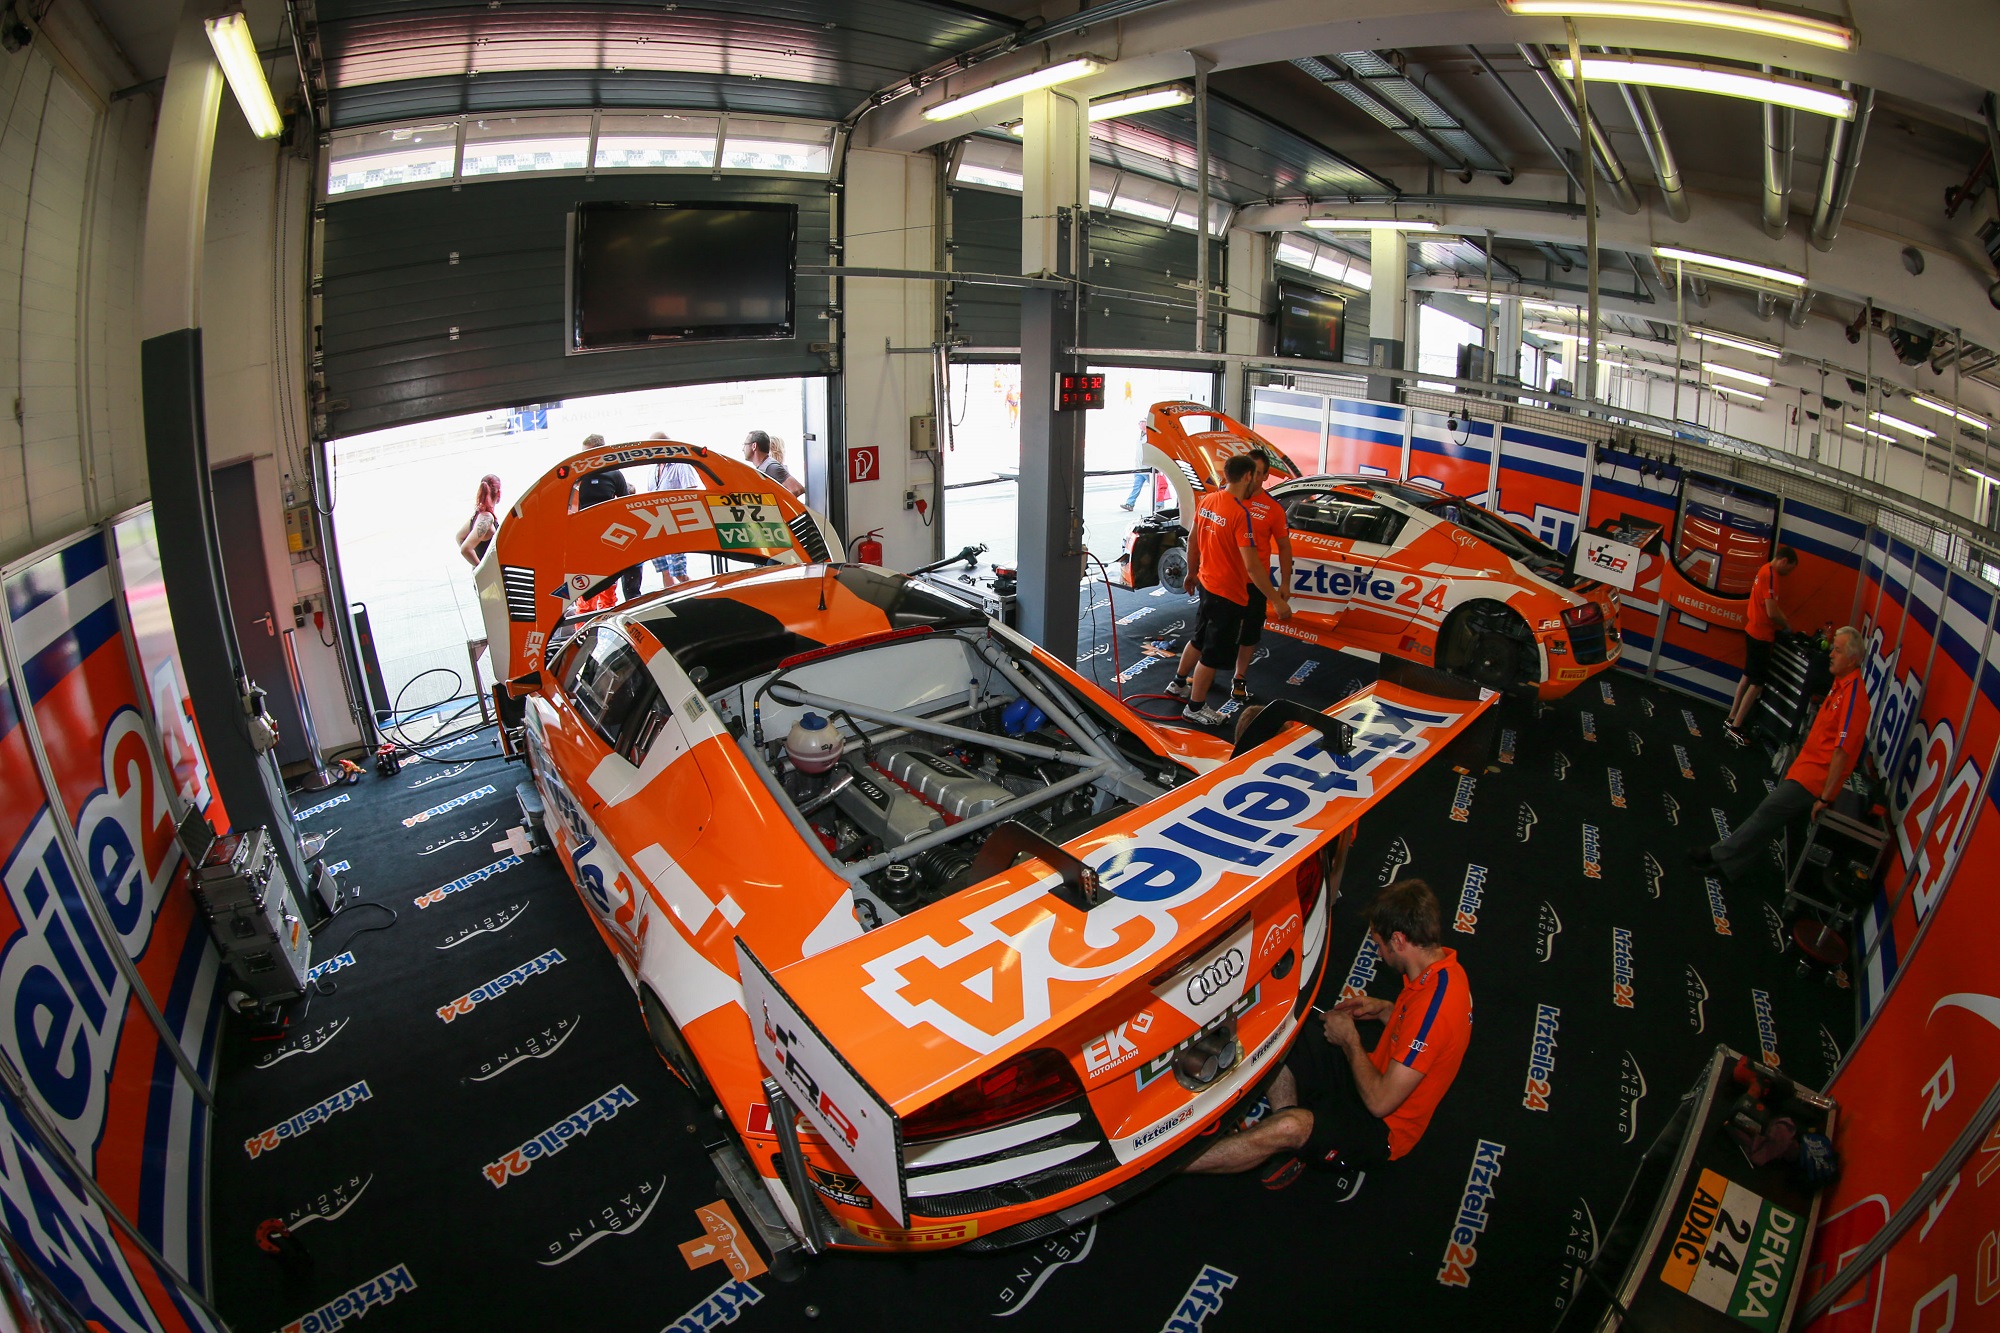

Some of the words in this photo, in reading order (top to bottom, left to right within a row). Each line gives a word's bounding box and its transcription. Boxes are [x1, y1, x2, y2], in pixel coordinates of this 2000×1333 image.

[571, 445, 692, 474] kfzteile24
[626, 493, 698, 510] AUTOMATION
[629, 500, 714, 540] EK
[730, 505, 766, 522] 24
[718, 527, 791, 545] DEKRA
[1288, 532, 1343, 548] ETSCHEK
[1677, 595, 1743, 623] NEMETSCHEK
[531, 631, 545, 658] EK
[402, 785, 497, 828] kfzteile24
[1449, 775, 1476, 823] kfzteile24
[426, 821, 489, 851] RACING
[1516, 805, 1526, 838] RACING
[1378, 840, 1400, 883] RACING
[1395, 850, 1406, 864] MS
[1583, 823, 1601, 879] kfzteile24
[414, 855, 524, 909] kfzteile24
[862, 694, 1462, 1055] kfzteile24
[1644, 855, 1655, 894] RACING
[1453, 863, 1488, 934] kfzteile24
[1704, 876, 1732, 936] kfzteile24
[445, 904, 519, 944] RACING
[486, 915, 510, 930] MS
[1263, 919, 1297, 957] RACING
[1268, 930, 1281, 943] MS
[1535, 905, 1548, 956] RACING
[1547, 917, 1554, 933] MS
[1762, 905, 1779, 949] RACING
[436, 948, 567, 1024] kfzteile24
[1613, 927, 1634, 1009] kfzteile24
[1685, 969, 1698, 1027] RACING
[1695, 981, 1703, 1000] MS
[262, 1019, 338, 1063] RACING
[301, 1034, 327, 1050] MS
[480, 1020, 567, 1072] RACING
[530, 1036, 557, 1054] MS
[1081, 1020, 1137, 1073] EK
[1752, 989, 1780, 1067] kfzteile2
[1089, 1049, 1139, 1079] AUTOMATION
[1523, 1003, 1560, 1112] kfzteile24
[1819, 1029, 1833, 1077] RACIN
[1618, 1058, 1630, 1134] RACING
[1630, 1074, 1640, 1097] MS
[244, 1079, 374, 1160] kfzteile24
[481, 1083, 640, 1189] kfzteile24
[1133, 1105, 1195, 1151] kfzteile24
[279, 1176, 360, 1222] RACIN
[321, 1194, 348, 1216] MS
[549, 1181, 652, 1256] RACING
[609, 1203, 643, 1231] MS
[1436, 1139, 1505, 1288] kfzteile24
[706, 1216, 743, 1270] RACING
[718, 1223, 732, 1241] MS
[1578, 1229, 1591, 1260] MS
[1673, 1186, 1719, 1266] ADAC
[1703, 1207, 1752, 1277] 24
[1000, 1237, 1057, 1303] CING
[1555, 1209, 1582, 1309] RACING
[1738, 1206, 1796, 1318] DEKRA
